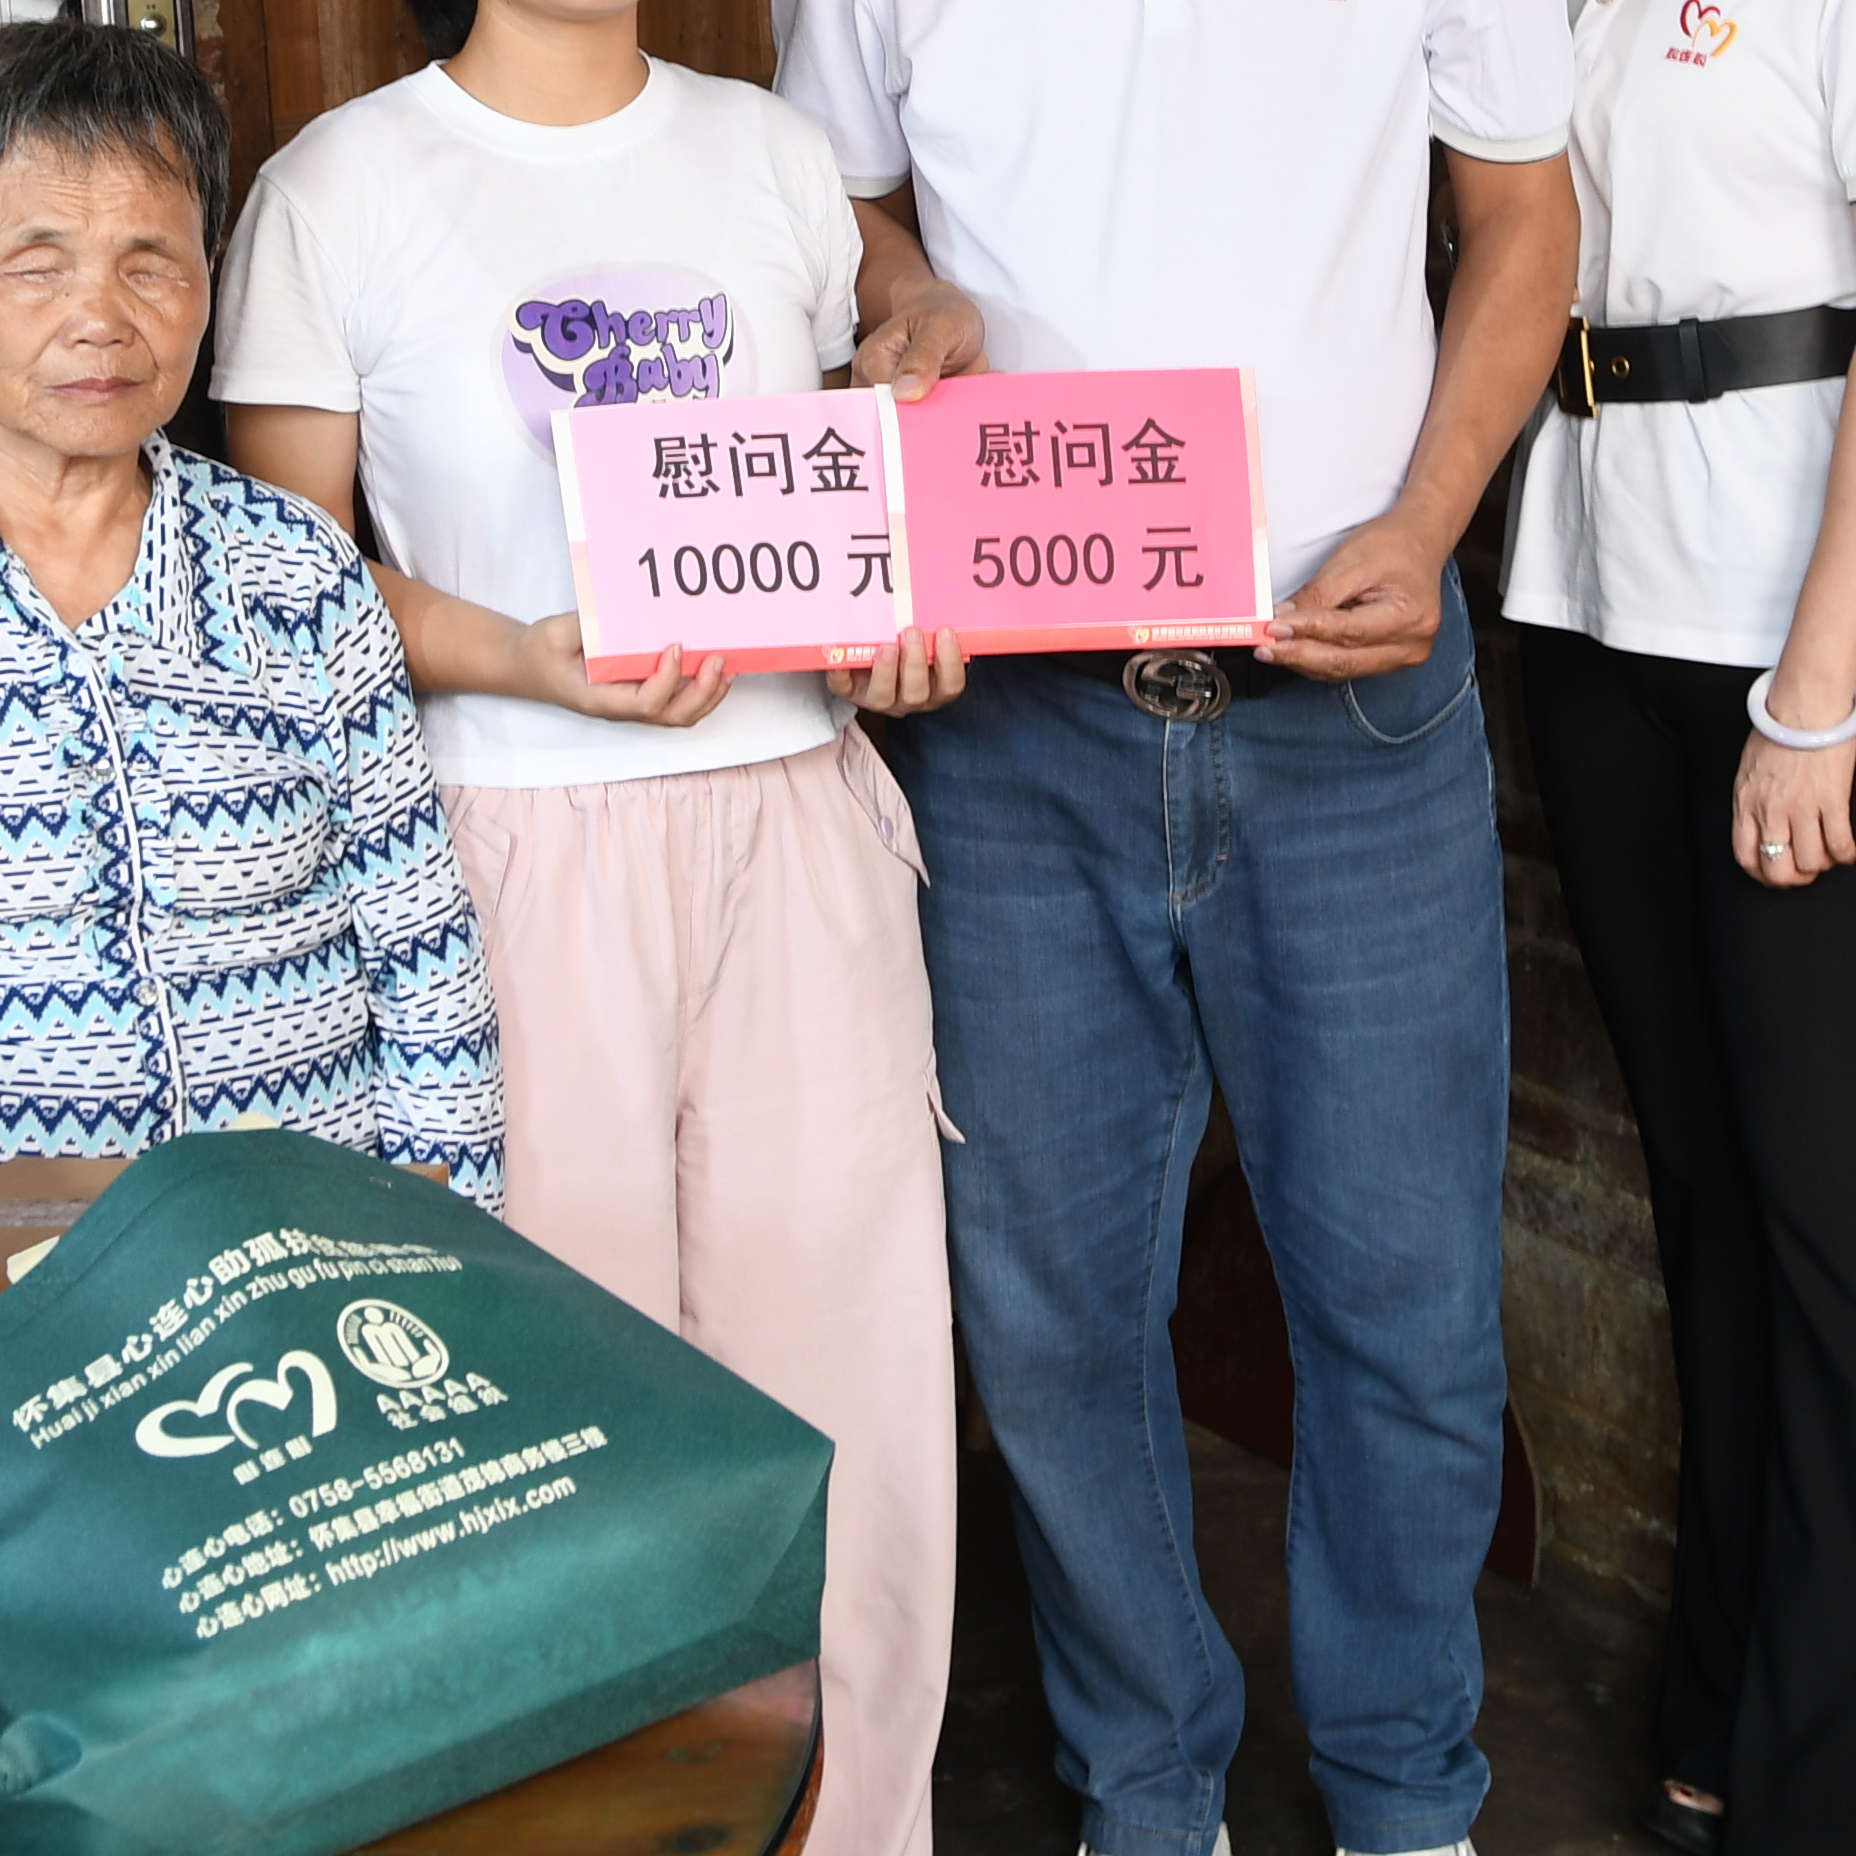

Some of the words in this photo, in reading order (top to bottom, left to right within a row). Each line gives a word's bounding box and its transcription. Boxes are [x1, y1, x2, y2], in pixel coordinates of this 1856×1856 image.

[515, 293, 728, 361] Cherry
[574, 343, 720, 408] Baby
[652, 426, 869, 499] 慰问金
[975, 417, 1186, 488] 慰问金
[638, 541, 820, 597] 10000
[847, 533, 894, 598] 元
[972, 533, 1115, 588] 5000
[1141, 527, 1204, 591] 元
[30, 1409, 83, 1450] Huai
[99, 1372, 148, 1410] xian
[146, 1346, 181, 1381] xin
[175, 1315, 217, 1357] lian
[213, 1288, 249, 1324] xin
[245, 1271, 289, 1301] zhu
[287, 1262, 318, 1290] gu
[312, 1256, 340, 1281] fu
[288, 1436, 466, 1519] 0758-5568131
